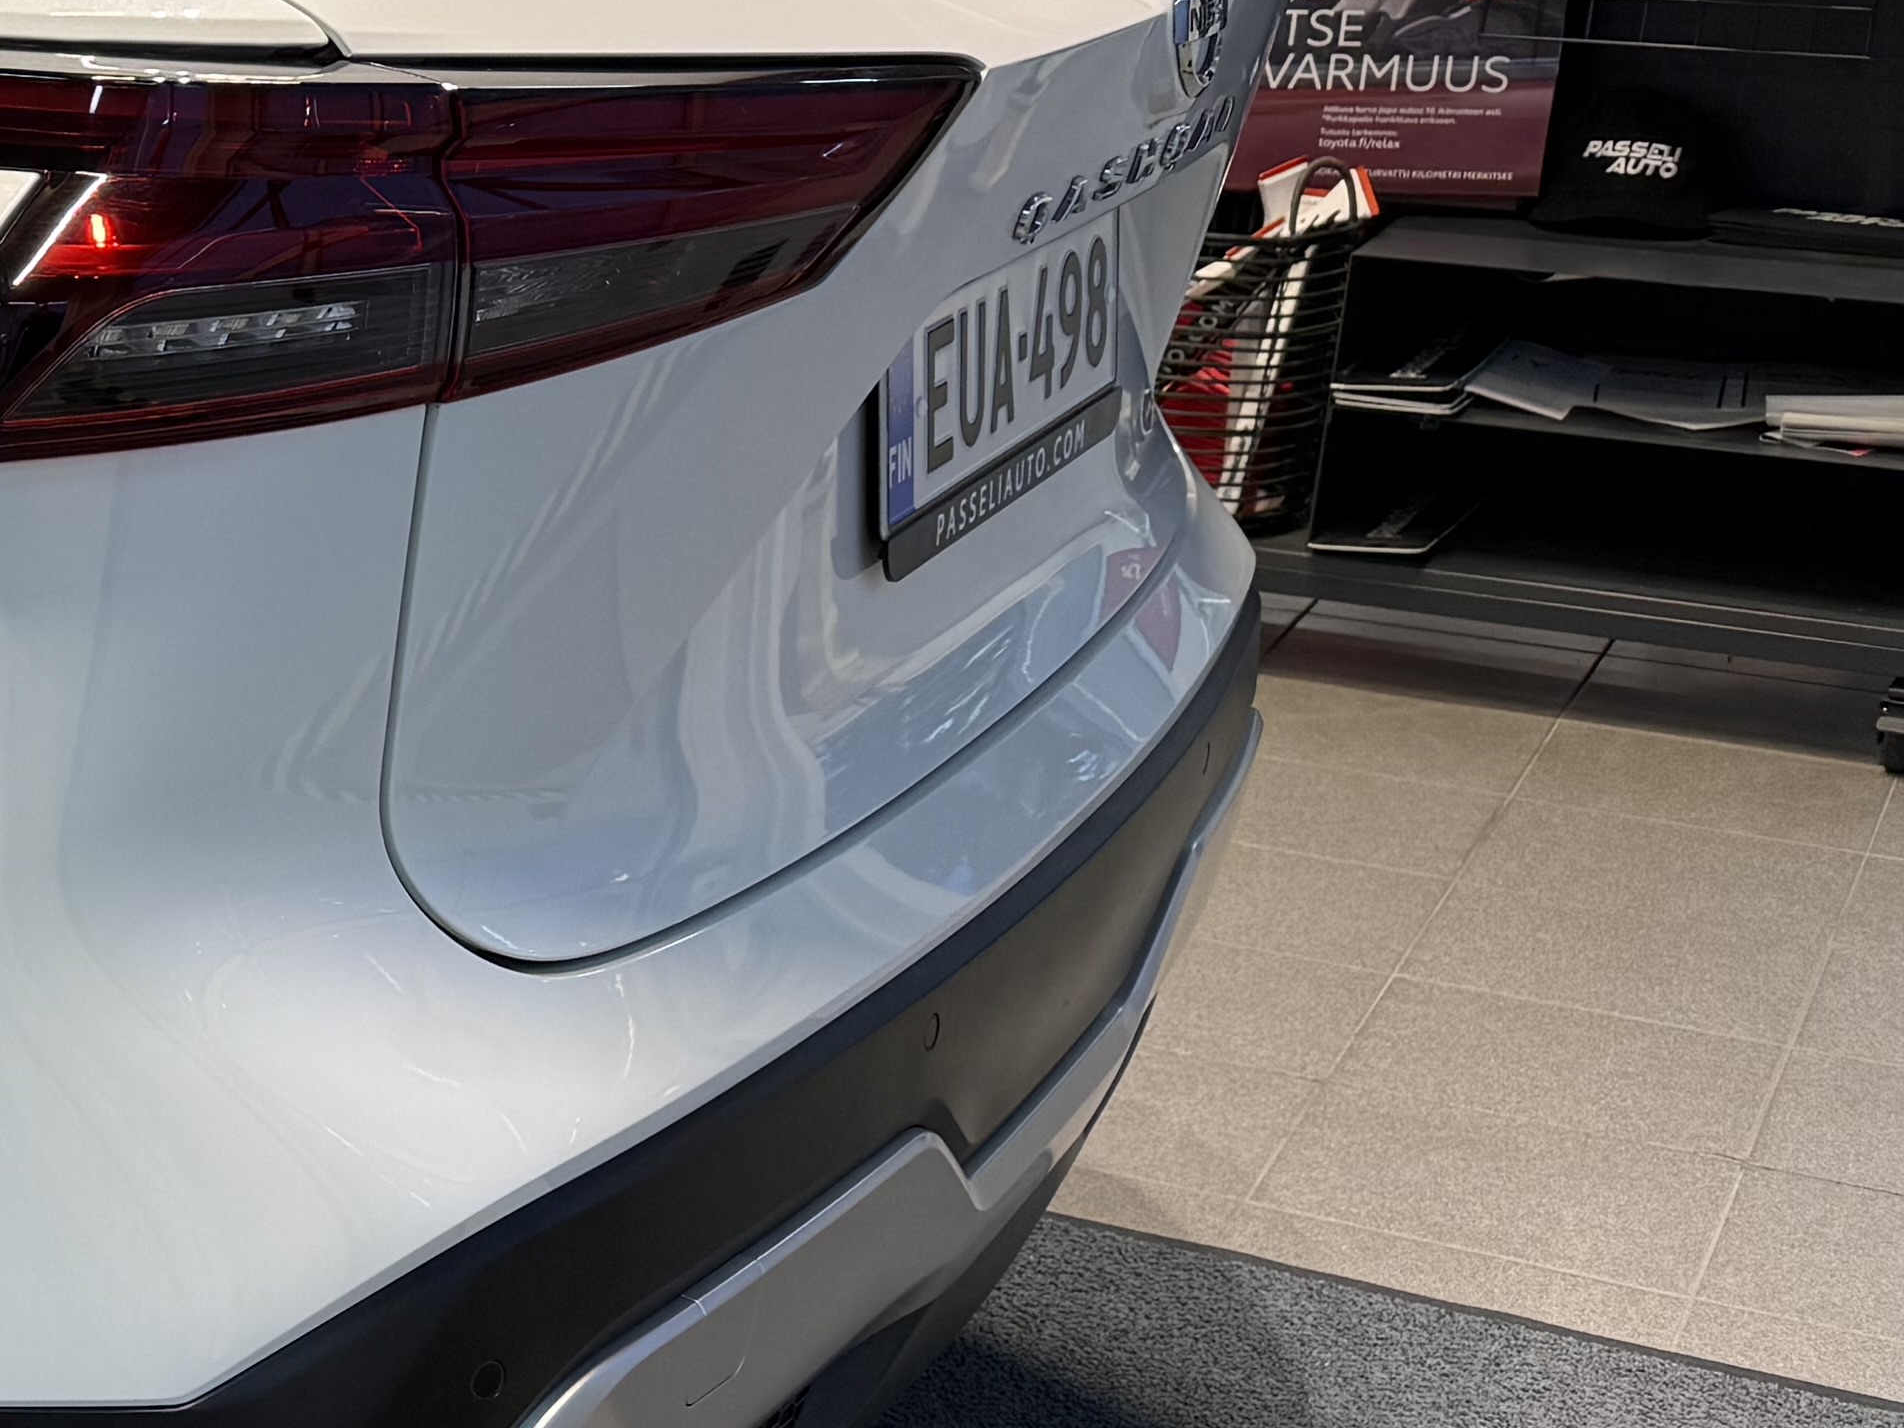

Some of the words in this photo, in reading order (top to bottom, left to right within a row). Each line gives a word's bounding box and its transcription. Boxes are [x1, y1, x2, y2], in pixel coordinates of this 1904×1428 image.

[1285, 9, 1366, 48] TSE
[1265, 53, 1512, 93] VARMUUS
[1012, 94, 1235, 246] QASHQAI
[1582, 139, 1683, 163] PASSELI
[1605, 157, 1679, 179] AUTO
[924, 235, 1108, 474] EUA-498
[889, 436, 913, 489] FIN
[935, 419, 1086, 548] PASSELIAUTO.COM
